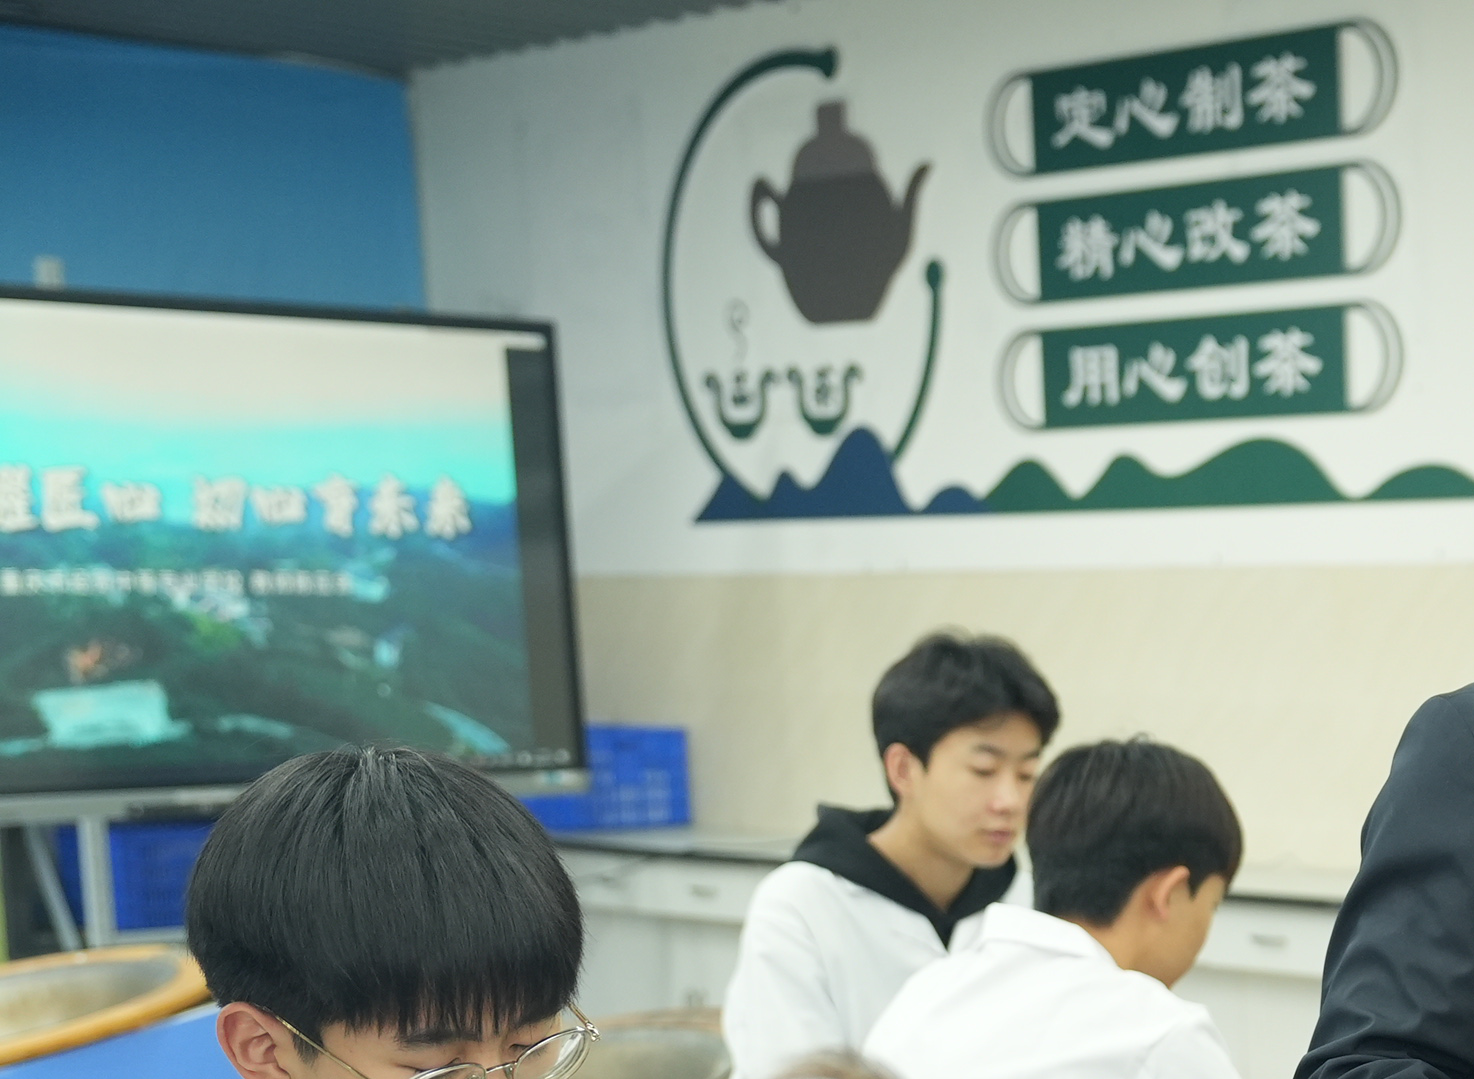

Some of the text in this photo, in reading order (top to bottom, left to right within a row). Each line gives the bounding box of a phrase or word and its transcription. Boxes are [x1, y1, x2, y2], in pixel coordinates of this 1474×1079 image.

[1052, 53, 1317, 149] 定心制茶
[1057, 190, 1322, 281] 精心改茶
[1063, 328, 1323, 408] 用心创茶
